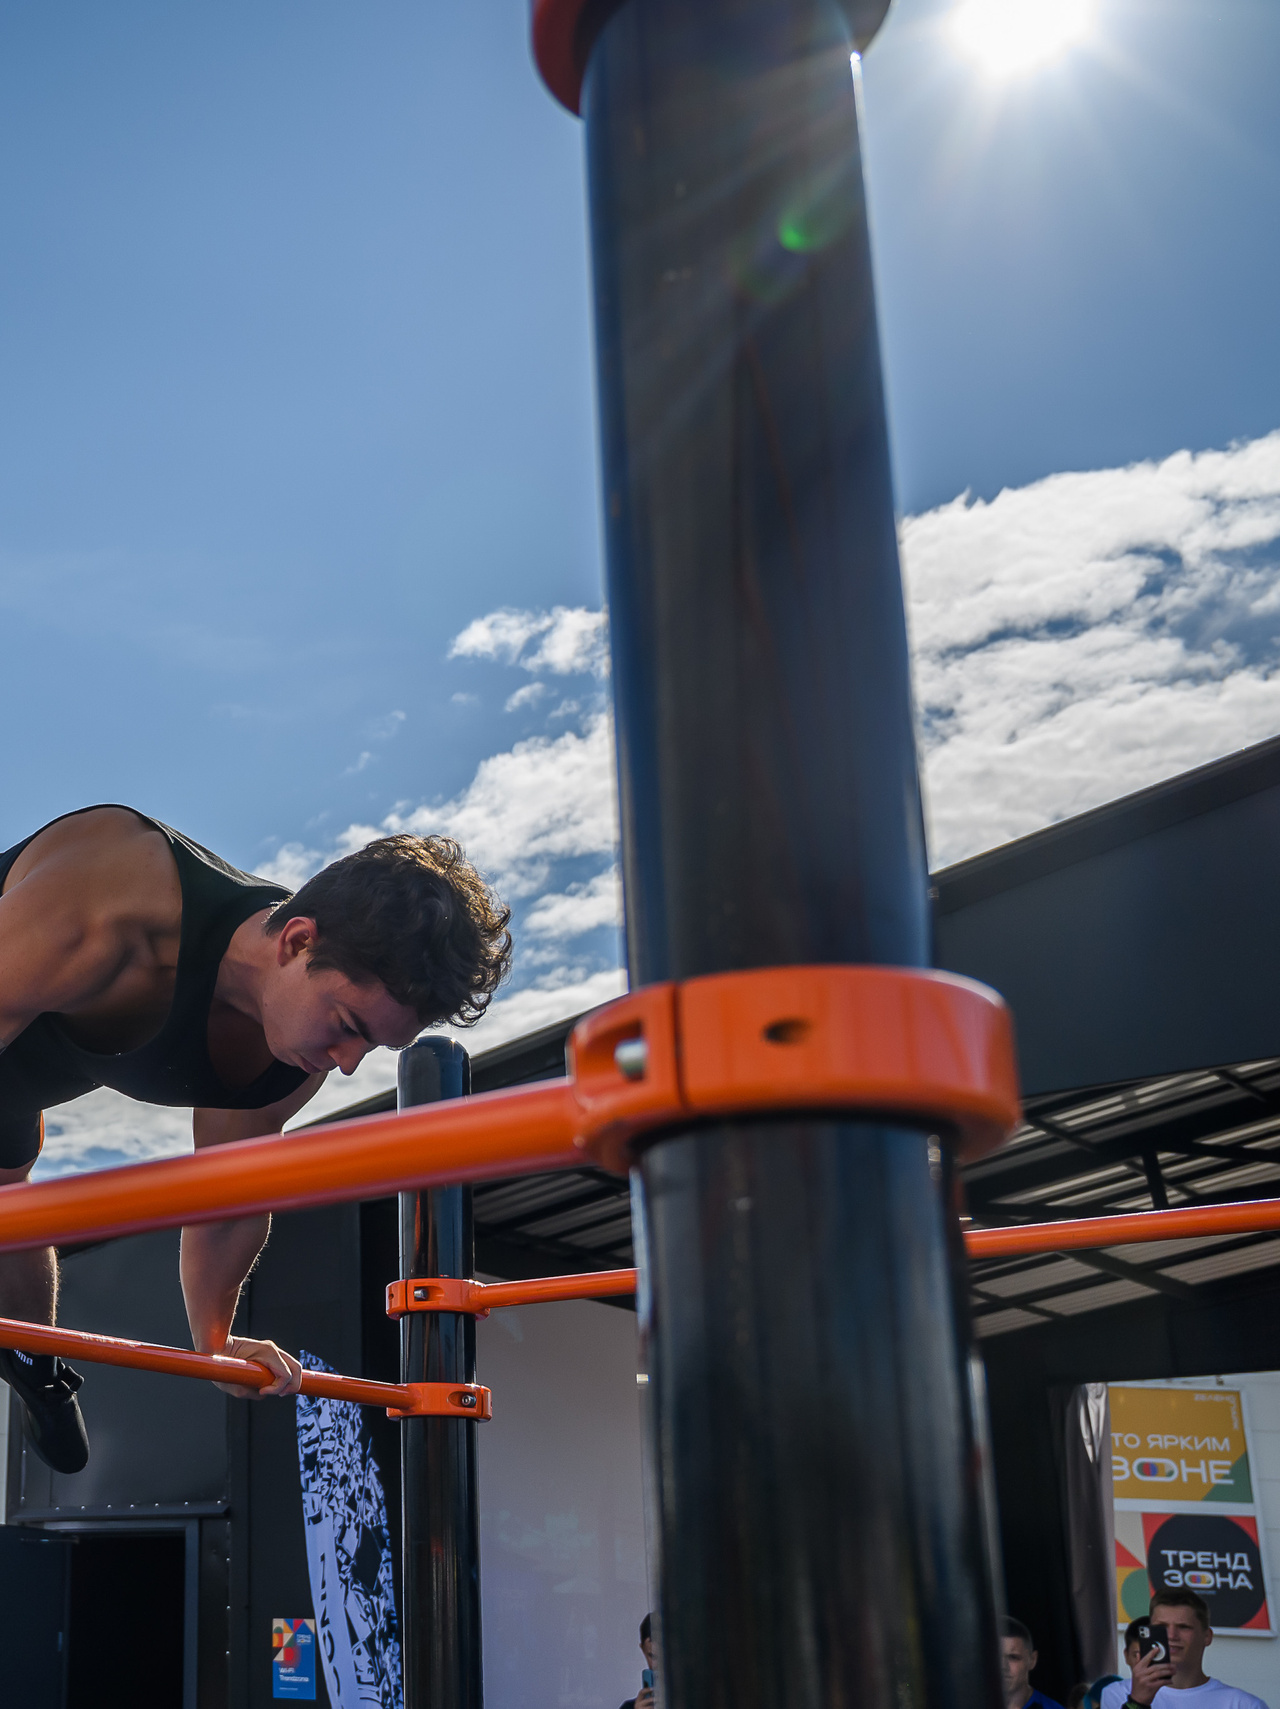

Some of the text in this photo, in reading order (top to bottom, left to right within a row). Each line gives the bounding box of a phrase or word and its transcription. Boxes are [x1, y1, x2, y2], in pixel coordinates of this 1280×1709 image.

[1146, 1433, 1231, 1452] ЯРКИМ
[1160, 1549, 1252, 1572] ТРЕНД
[1163, 1569, 1254, 1590] ЗОНА
